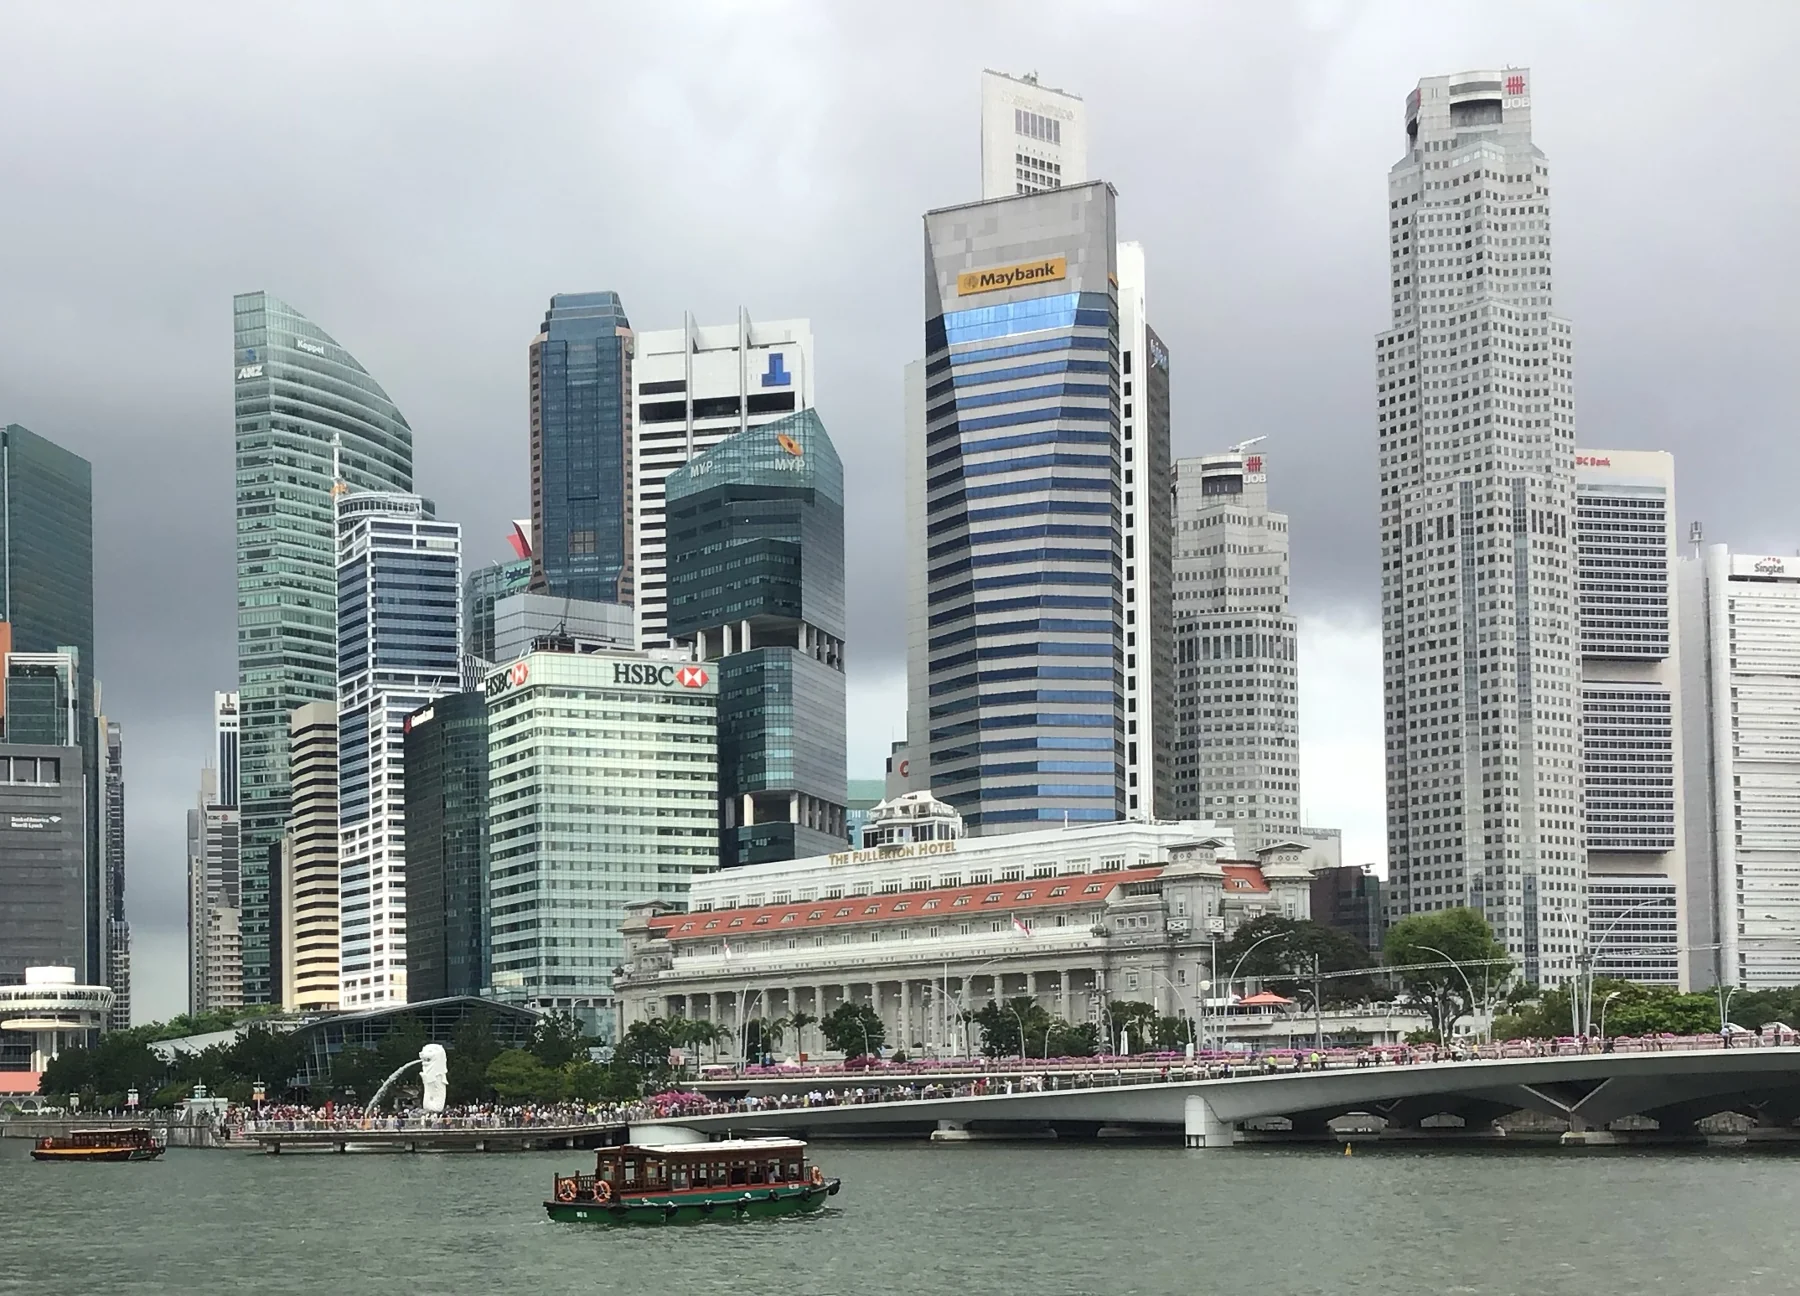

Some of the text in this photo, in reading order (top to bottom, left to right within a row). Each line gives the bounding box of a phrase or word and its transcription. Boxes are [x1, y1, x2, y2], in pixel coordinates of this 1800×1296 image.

[1502, 97, 1531, 109] UOB
[980, 263, 1055, 286] Maybank
[297, 339, 324, 355] Keppel
[237, 365, 263, 380] ANZ
[690, 460, 713, 478] MYP
[774, 458, 806, 472] MYP
[1242, 473, 1266, 484] UOB
[1754, 562, 1785, 575] Singtel
[613, 663, 674, 685] HSBC
[485, 668, 512, 698] HSBC
[829, 841, 956, 865] THE FULLERTON HOTEL
